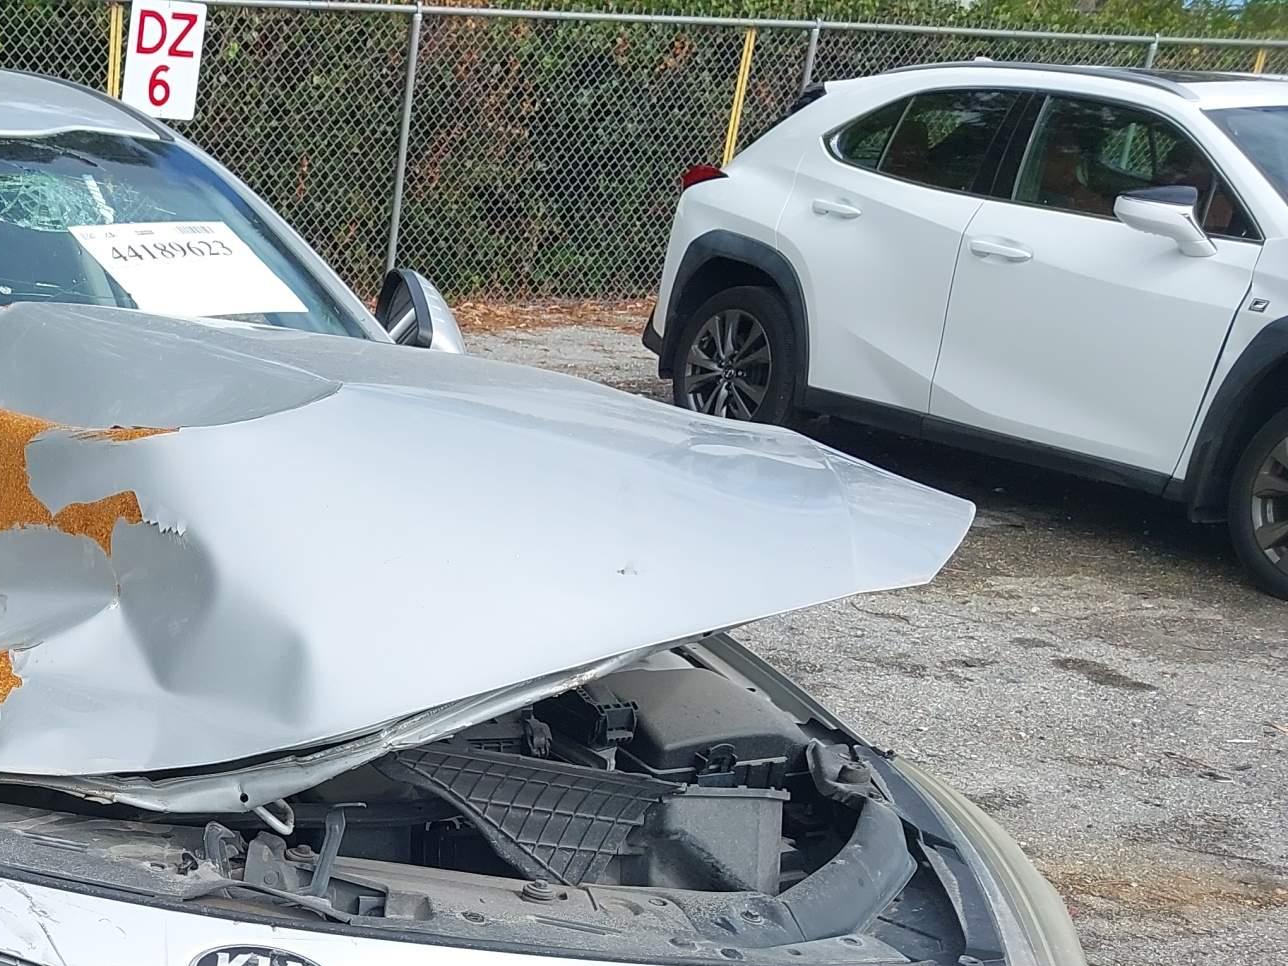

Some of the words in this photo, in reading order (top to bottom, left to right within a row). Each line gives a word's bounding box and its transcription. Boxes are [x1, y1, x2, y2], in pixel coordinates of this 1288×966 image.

[136, 9, 198, 58] DZ
[148, 64, 170, 107] 6
[111, 240, 233, 262] 44189623
